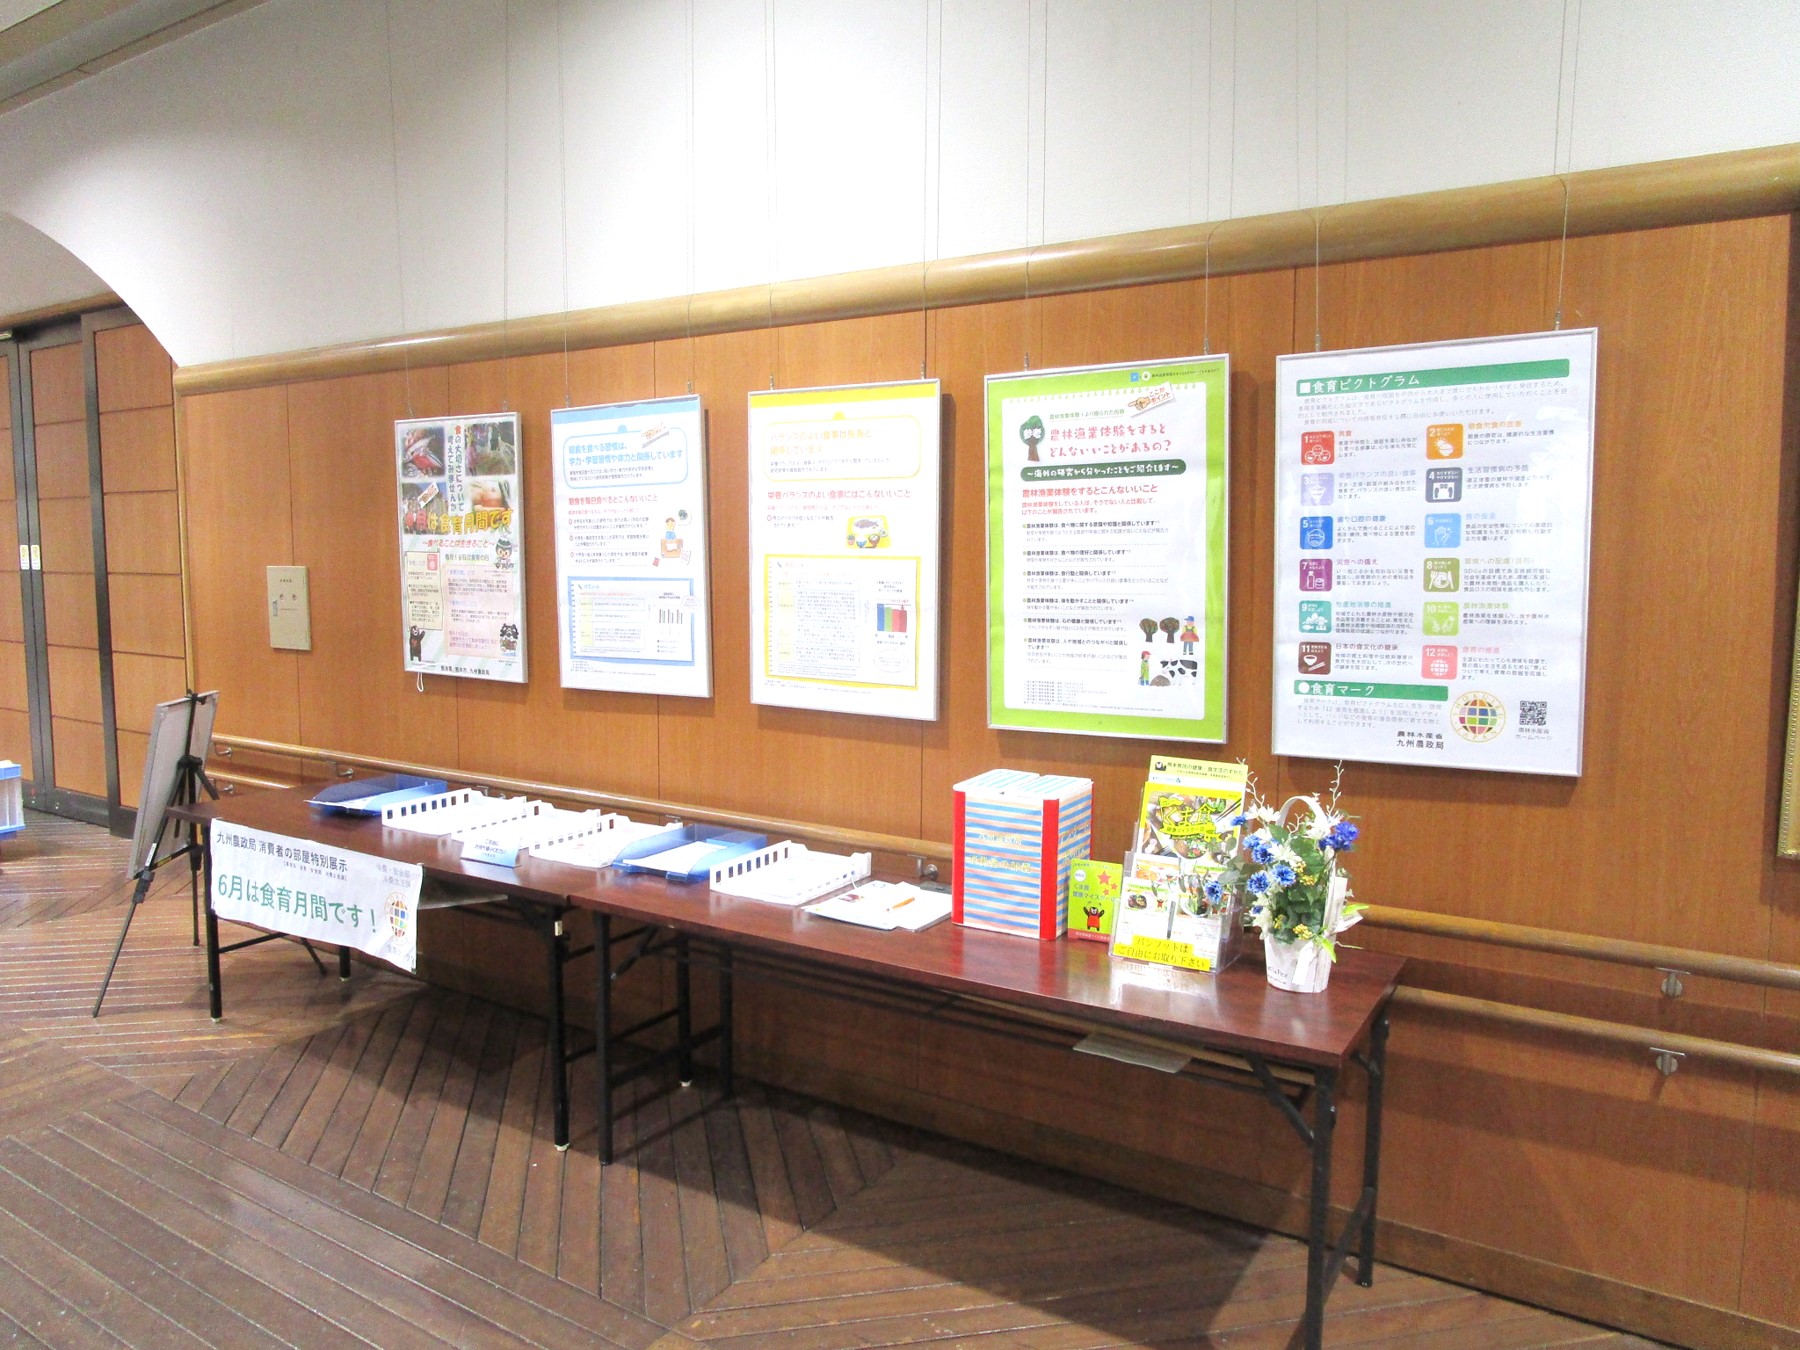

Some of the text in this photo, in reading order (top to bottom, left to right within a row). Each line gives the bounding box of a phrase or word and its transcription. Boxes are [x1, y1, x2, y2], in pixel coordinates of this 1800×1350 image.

[1312, 375, 1420, 393] 食育ピクトグラム
[770, 428, 873, 442] バランスのよい食事はと
[1050, 423, 1166, 441] 農林漁業体験をすると
[1429, 428, 1435, 437] 2
[1467, 464, 1529, 474] 生活習慣病の予防
[1429, 471, 1434, 479] 4
[1022, 484, 1158, 498] 農林漁業体験をするとこんないいこと
[1302, 520, 1308, 528] 5
[1427, 517, 1434, 526] 6
[1302, 562, 1307, 570] 7
[1336, 558, 1378, 566] 災害への備え
[1426, 561, 1433, 570] 8
[1301, 603, 1307, 612] 9
[1301, 645, 1310, 653] 11
[1335, 643, 1398, 651] 日本の食文化の継承
[1425, 648, 1436, 657] 12
[1310, 682, 1375, 696] 食育マーク
[1396, 730, 1443, 739] 農林水産省
[1396, 738, 1444, 750] 九州農政局
[1164, 803, 1216, 827] くま食
[216, 831, 348, 873] 九州農政局 消費者の部屋特別展示
[1118, 945, 1205, 968] ご自由にお取り下さい
